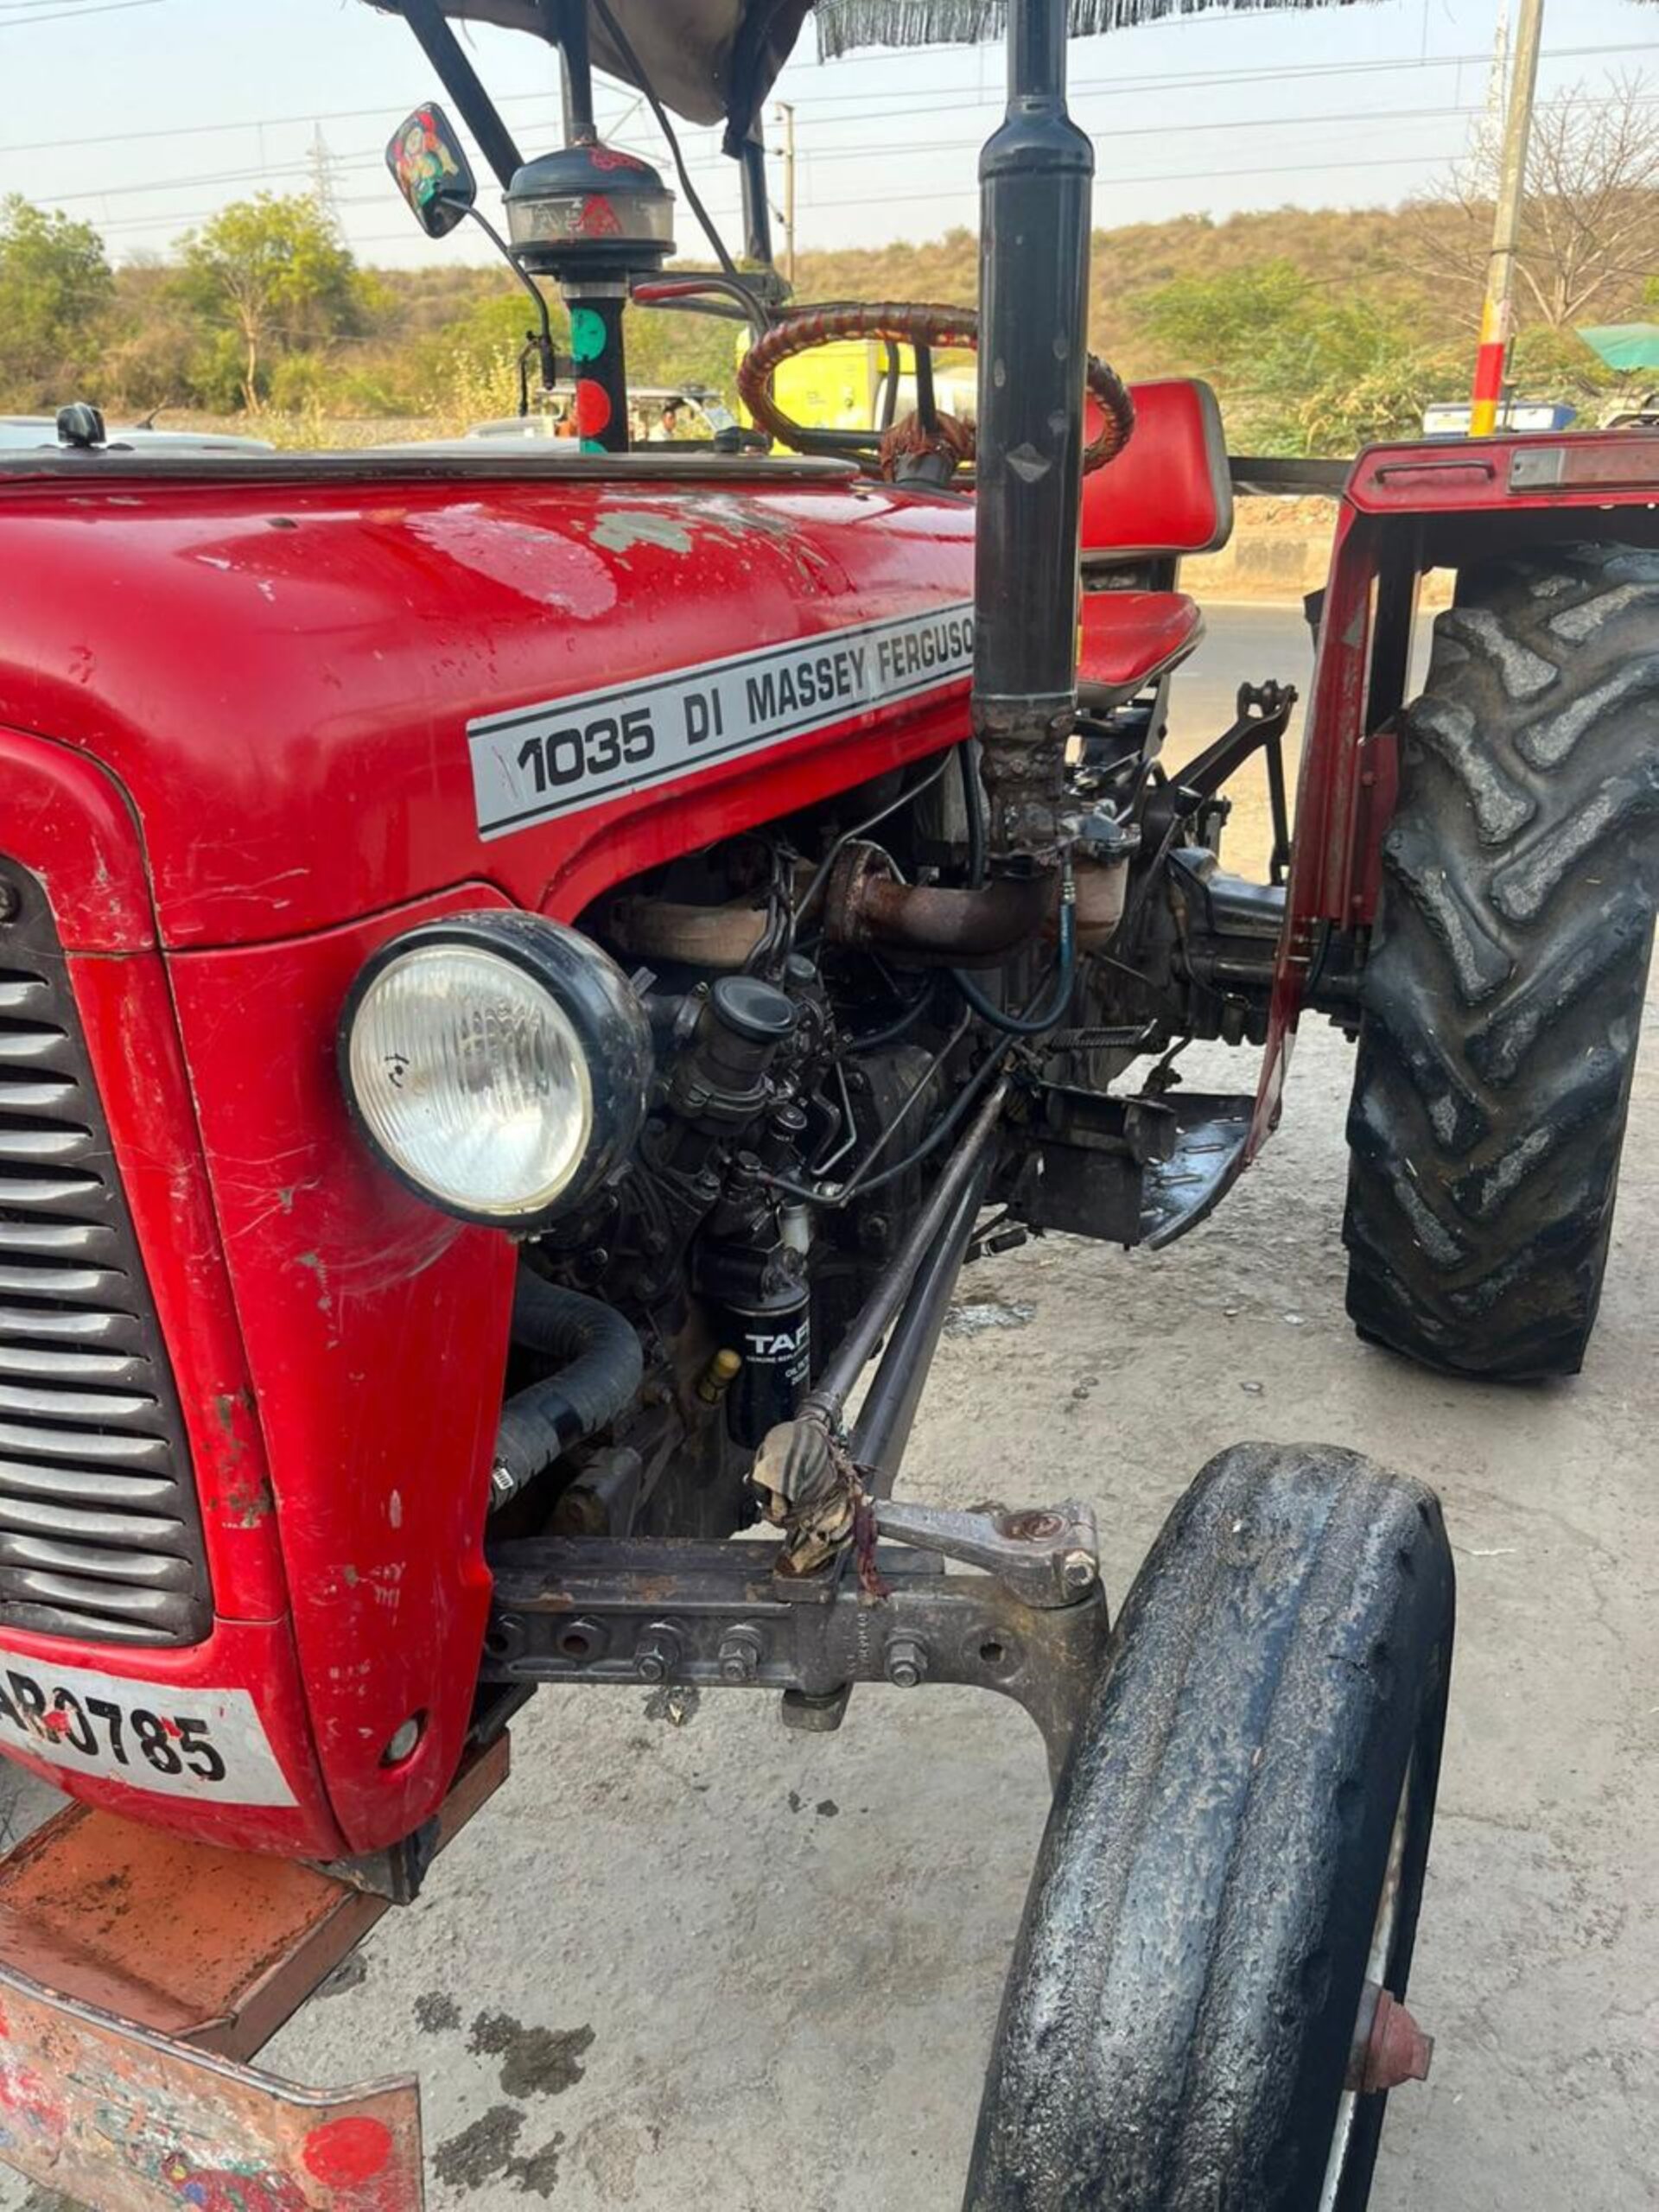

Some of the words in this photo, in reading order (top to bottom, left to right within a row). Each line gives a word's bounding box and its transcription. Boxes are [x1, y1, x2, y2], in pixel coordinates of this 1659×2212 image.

[518, 708, 655, 793] 1035
[683, 689, 723, 747] DI
[746, 647, 865, 724] MASSEY
